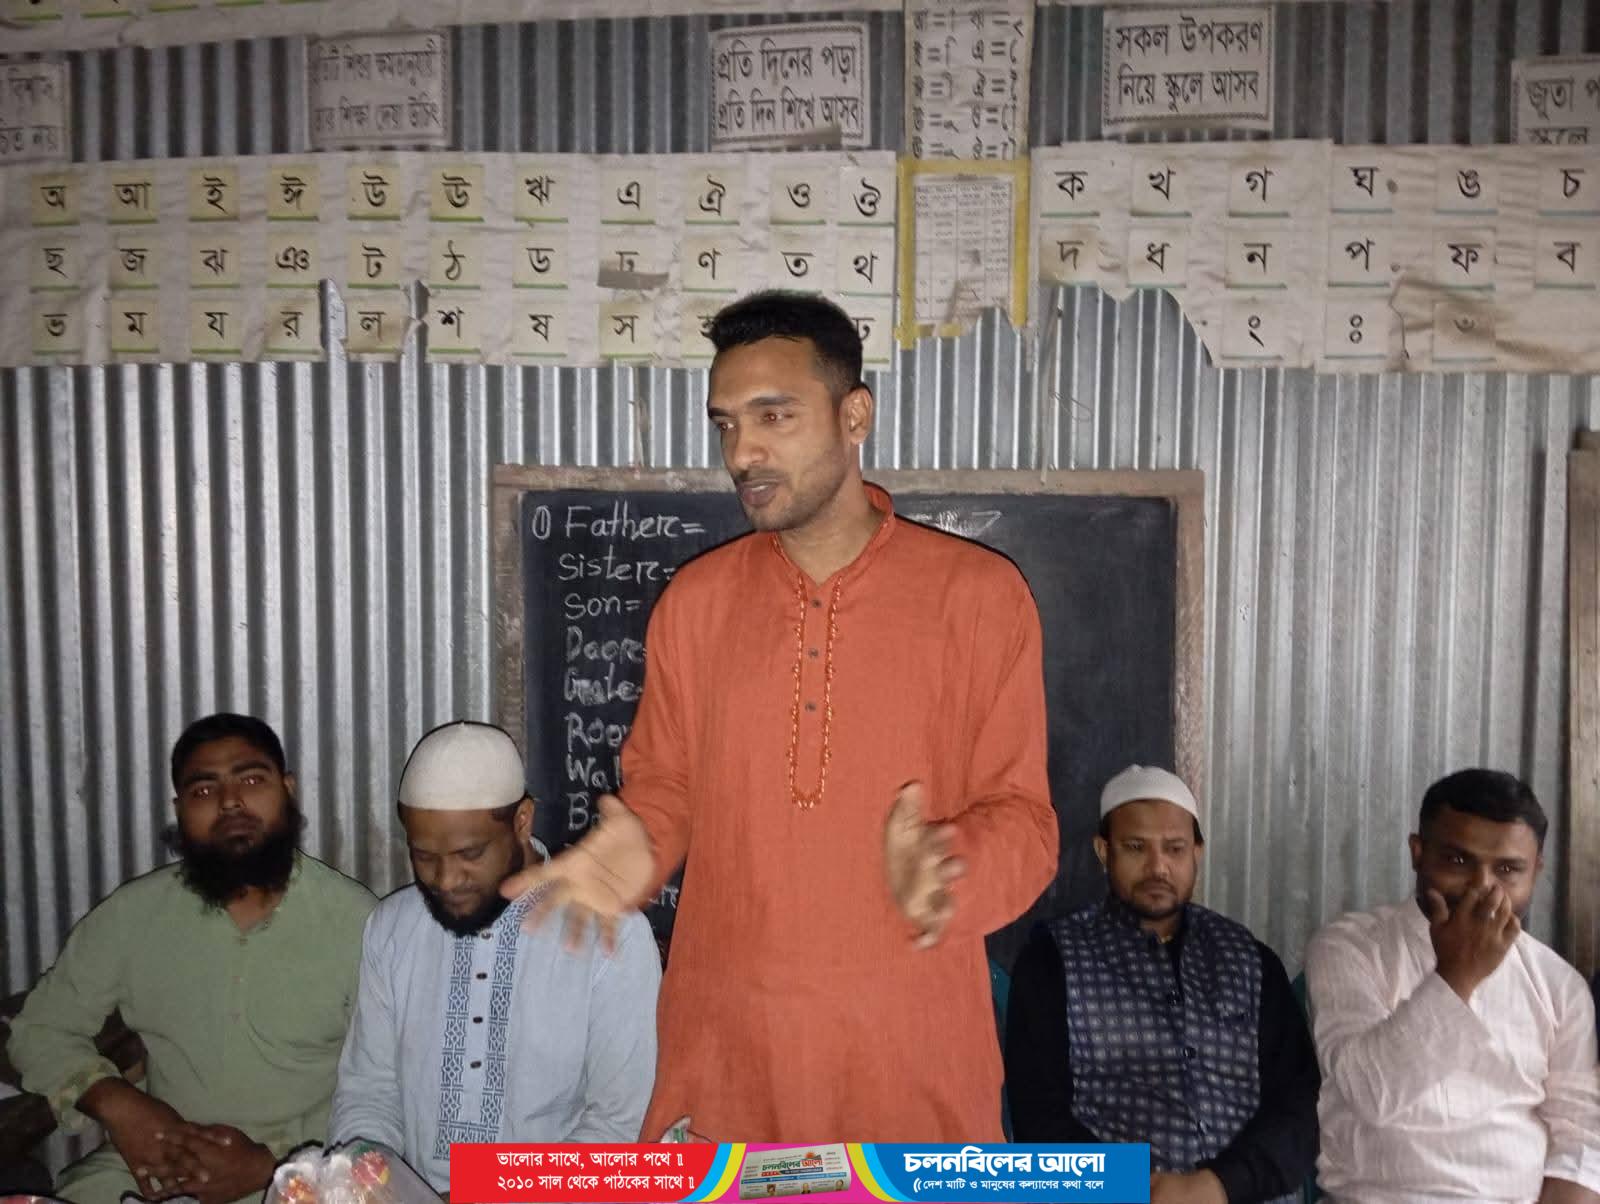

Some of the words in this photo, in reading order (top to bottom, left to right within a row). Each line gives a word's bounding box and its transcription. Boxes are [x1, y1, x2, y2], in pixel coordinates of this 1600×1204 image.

[1116, 23, 1168, 58] সকল
[1180, 14, 1263, 56] উপকরণ
[717, 38, 753, 83] প্রতি
[760, 37, 812, 82] দিনের
[821, 43, 856, 84] পড়া
[718, 88, 746, 132] প্রতি
[750, 87, 776, 130] দিন
[820, 95, 860, 132] আসব
[1117, 64, 1157, 105] নিয়ে
[1164, 71, 1203, 112] স্কুলে
[1211, 69, 1260, 101] আসব
[1526, 74, 1575, 121] জুতা
[39, 185, 67, 209] অ
[113, 181, 152, 208] আ
[202, 176, 228, 215] ই
[361, 171, 390, 208] উ
[441, 173, 473, 209] ঊ
[524, 175, 556, 206] ঋ
[616, 180, 641, 211] এ
[698, 174, 727, 217] ঐ
[785, 182, 812, 209] ও
[852, 177, 882, 218] ঔ
[1054, 170, 1089, 201] ক
[1147, 167, 1177, 201] খ
[1245, 165, 1274, 203] গ
[1349, 166, 1380, 198] ঘ
[1456, 169, 1481, 200] ঙ
[1559, 168, 1585, 199] চ
[43, 247, 66, 277] ছ
[119, 247, 149, 272] জ
[199, 248, 229, 275] ঝ
[274, 246, 310, 273] ঞ
[361, 244, 387, 279] ট
[442, 239, 466, 282] ঠ
[525, 247, 556, 275] ড
[697, 247, 722, 281] ণ
[780, 251, 814, 279] ত
[852, 251, 879, 285] থ
[1056, 239, 1085, 270] দ
[1145, 242, 1171, 273] ধ
[1243, 242, 1273, 273] ন
[1344, 237, 1375, 273] প
[1447, 243, 1483, 274] ফ
[1553, 241, 1581, 273] ব
[42, 313, 68, 337] ভ
[123, 311, 148, 337] ম
[203, 311, 229, 339] য
[279, 310, 303, 338] র
[357, 311, 386, 339] ল
[439, 306, 462, 339] শ
[527, 313, 554, 343] ষ
[614, 314, 637, 344] স
[1247, 315, 1265, 348] ং
[1348, 314, 1364, 345] ঃ
[563, 712, 630, 752] Roo
